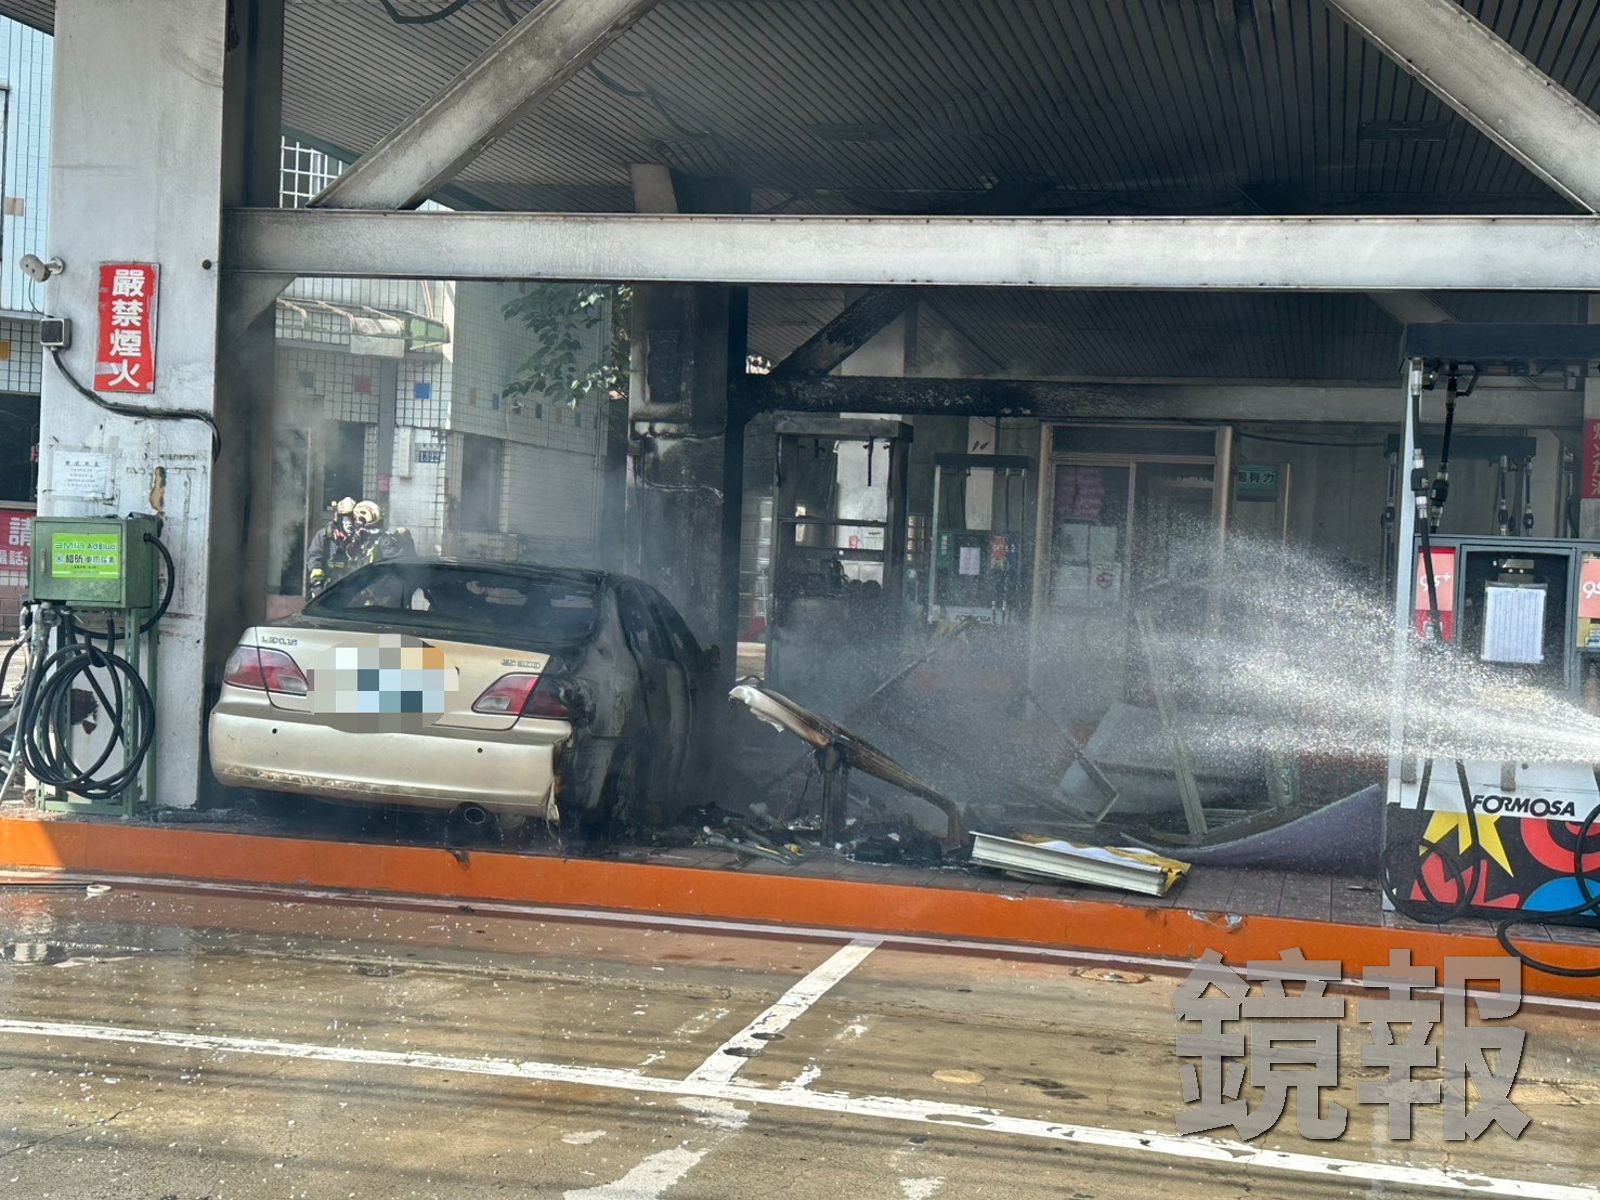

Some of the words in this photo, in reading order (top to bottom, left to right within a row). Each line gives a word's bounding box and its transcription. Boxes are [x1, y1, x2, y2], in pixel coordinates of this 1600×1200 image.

[108, 269, 145, 387] 嚴禁煙火
[1473, 795, 1575, 817] FORMOSA
